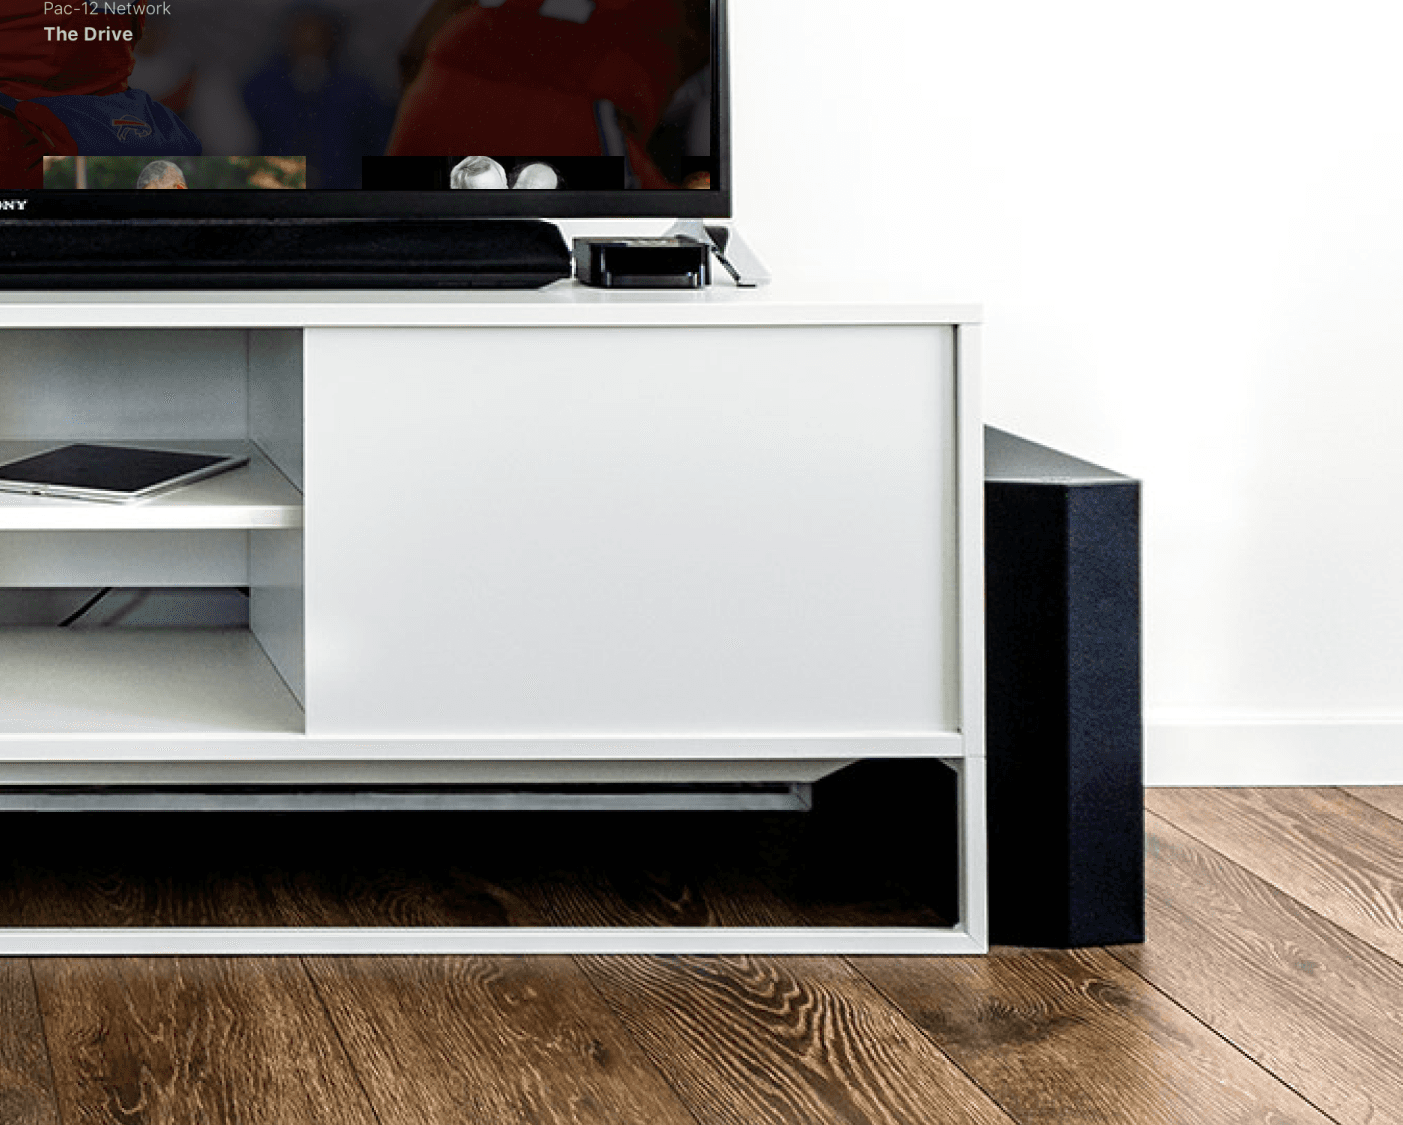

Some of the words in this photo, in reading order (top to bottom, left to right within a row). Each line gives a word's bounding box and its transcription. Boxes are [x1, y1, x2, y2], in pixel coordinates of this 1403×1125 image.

[44, 1, 99, 15] Pac-12
[104, 1, 171, 15] Network
[43, 26, 79, 42] The
[84, 26, 133, 42] Drive
